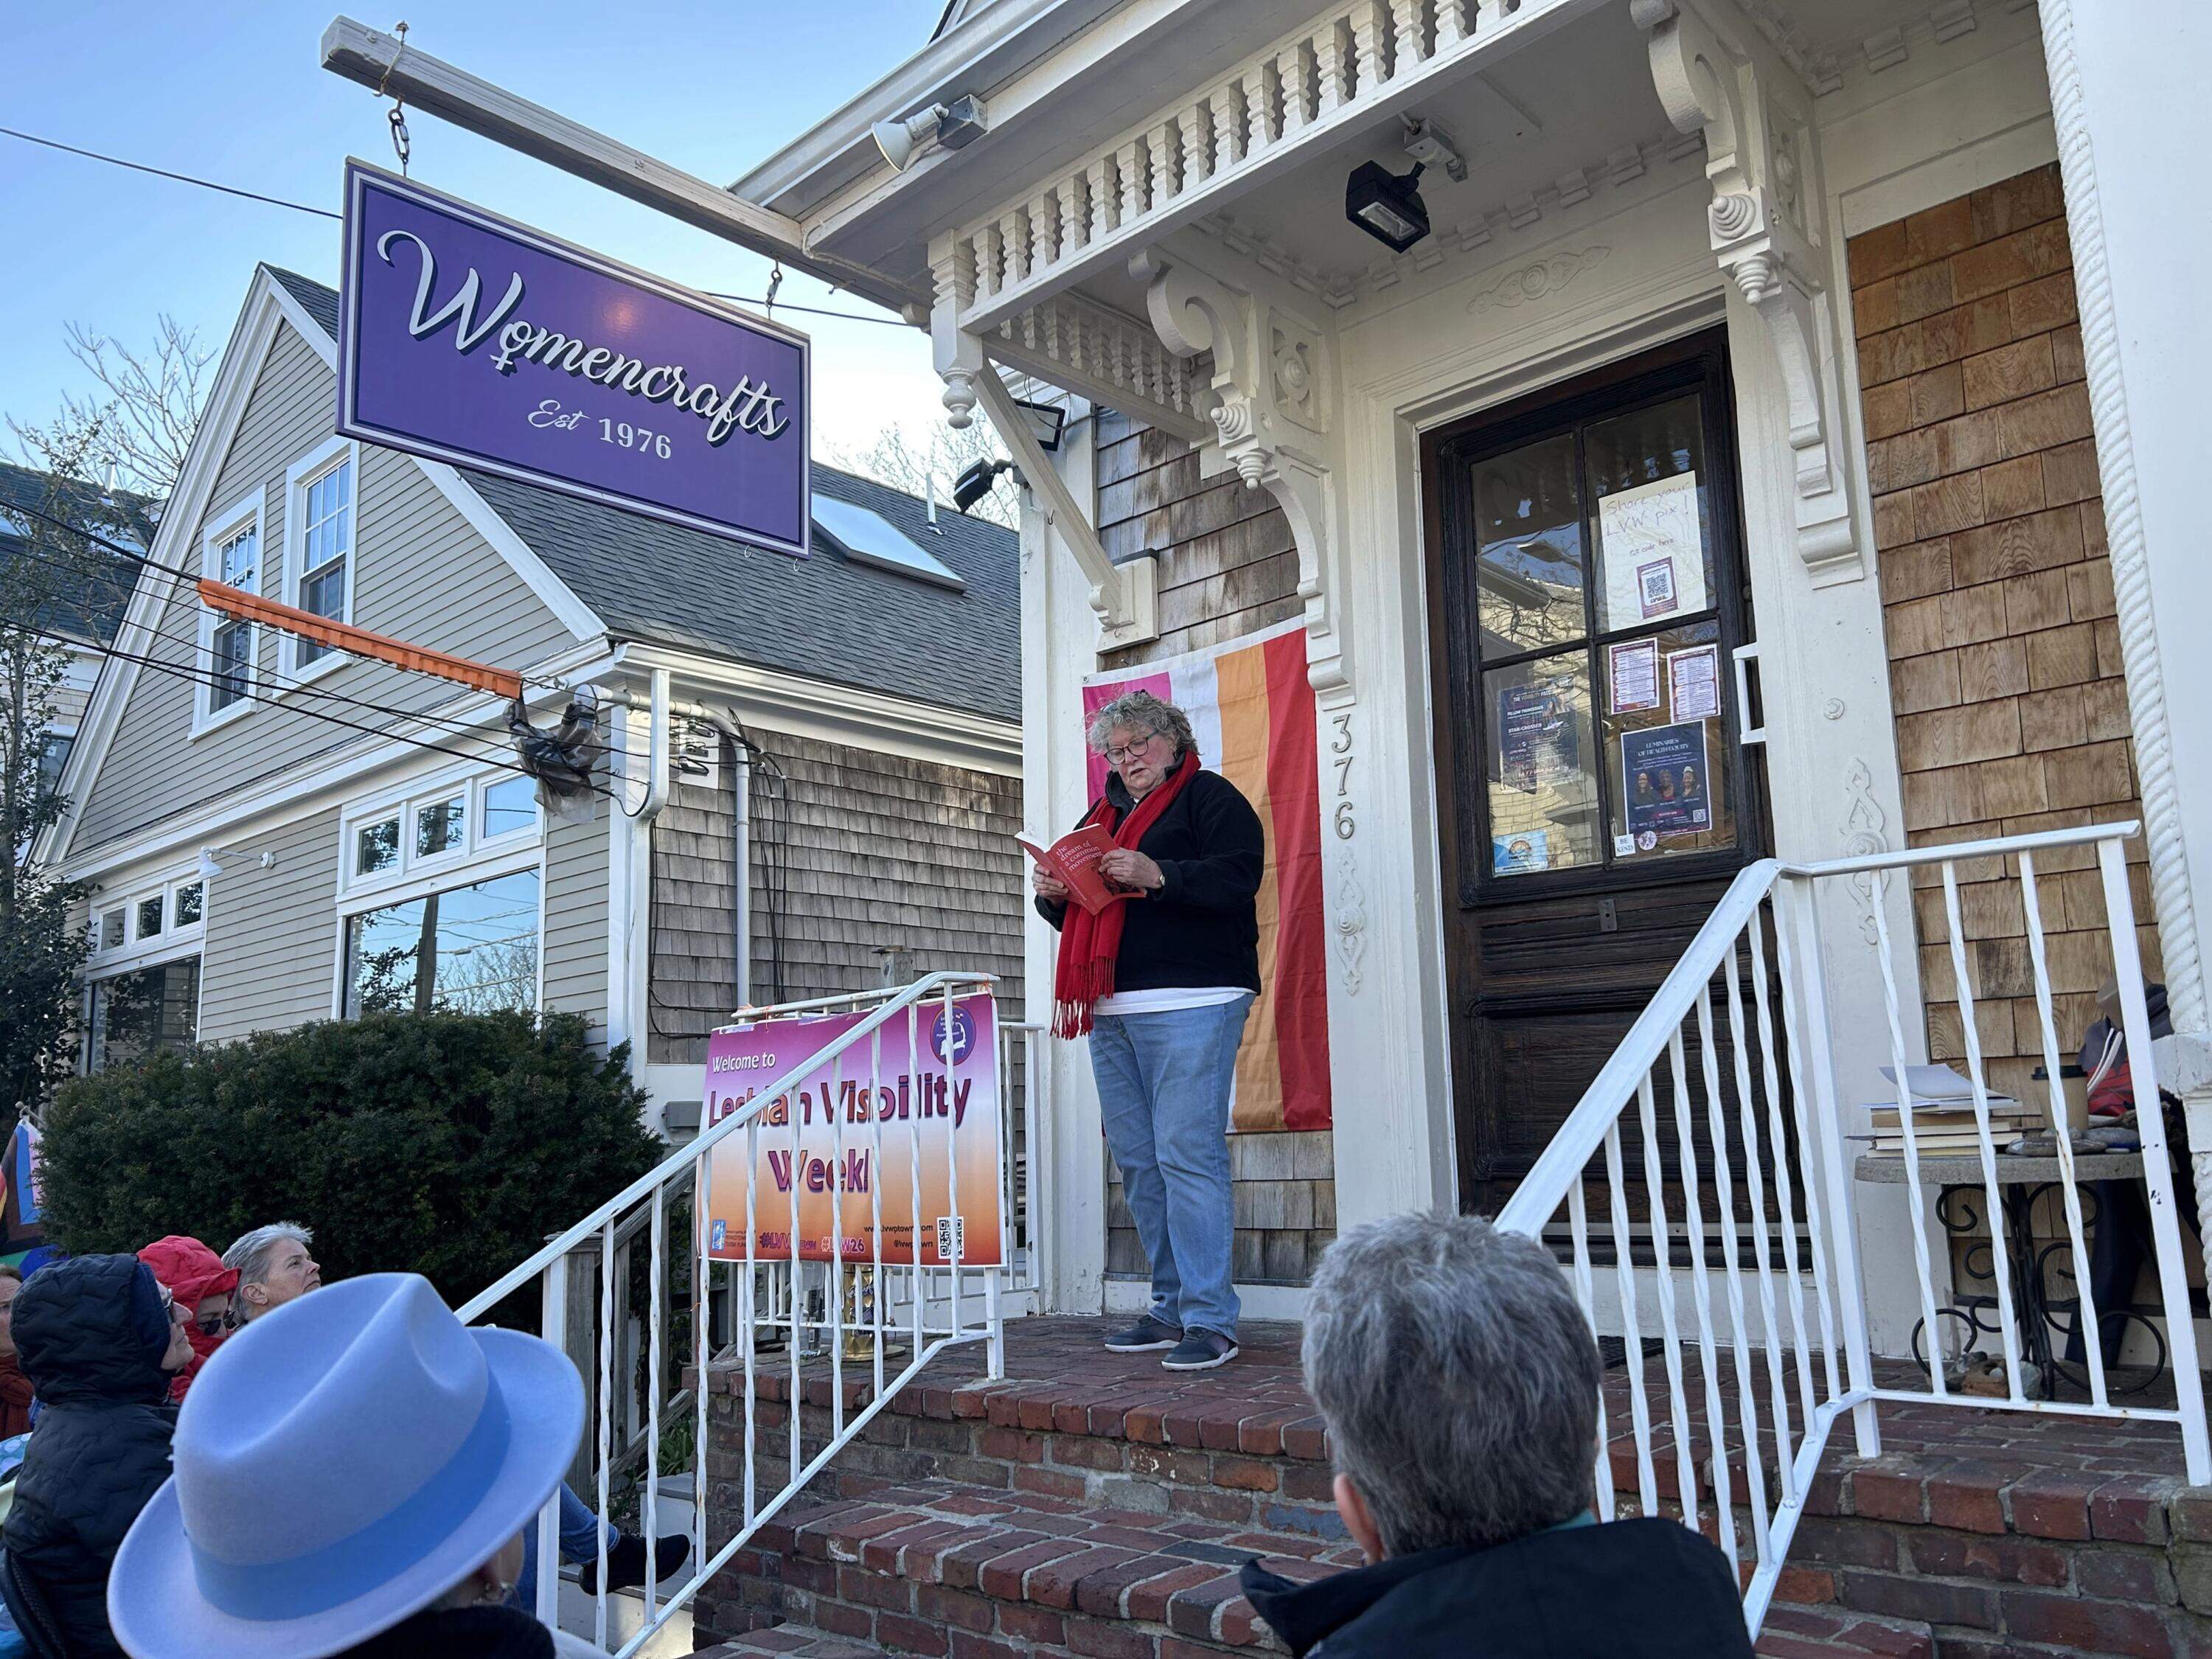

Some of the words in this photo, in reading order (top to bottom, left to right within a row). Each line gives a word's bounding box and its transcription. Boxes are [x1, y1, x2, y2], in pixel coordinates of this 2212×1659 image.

[377, 229, 792, 448] Womencrafts
[526, 399, 589, 431] Est
[598, 417, 672, 461] 1976
[1606, 496, 1649, 515] Share
[1606, 509, 1646, 537] LVW
[1056, 845, 1068, 856] the
[1060, 844, 1082, 861] dream
[1082, 840, 1091, 848] of
[1616, 844, 1634, 854] KIND
[1619, 837, 1629, 845] BE
[1068, 851, 1103, 872] movement
[1070, 846, 1099, 862] common
[712, 1054, 759, 1074] Welcome
[762, 1051, 776, 1068] to
